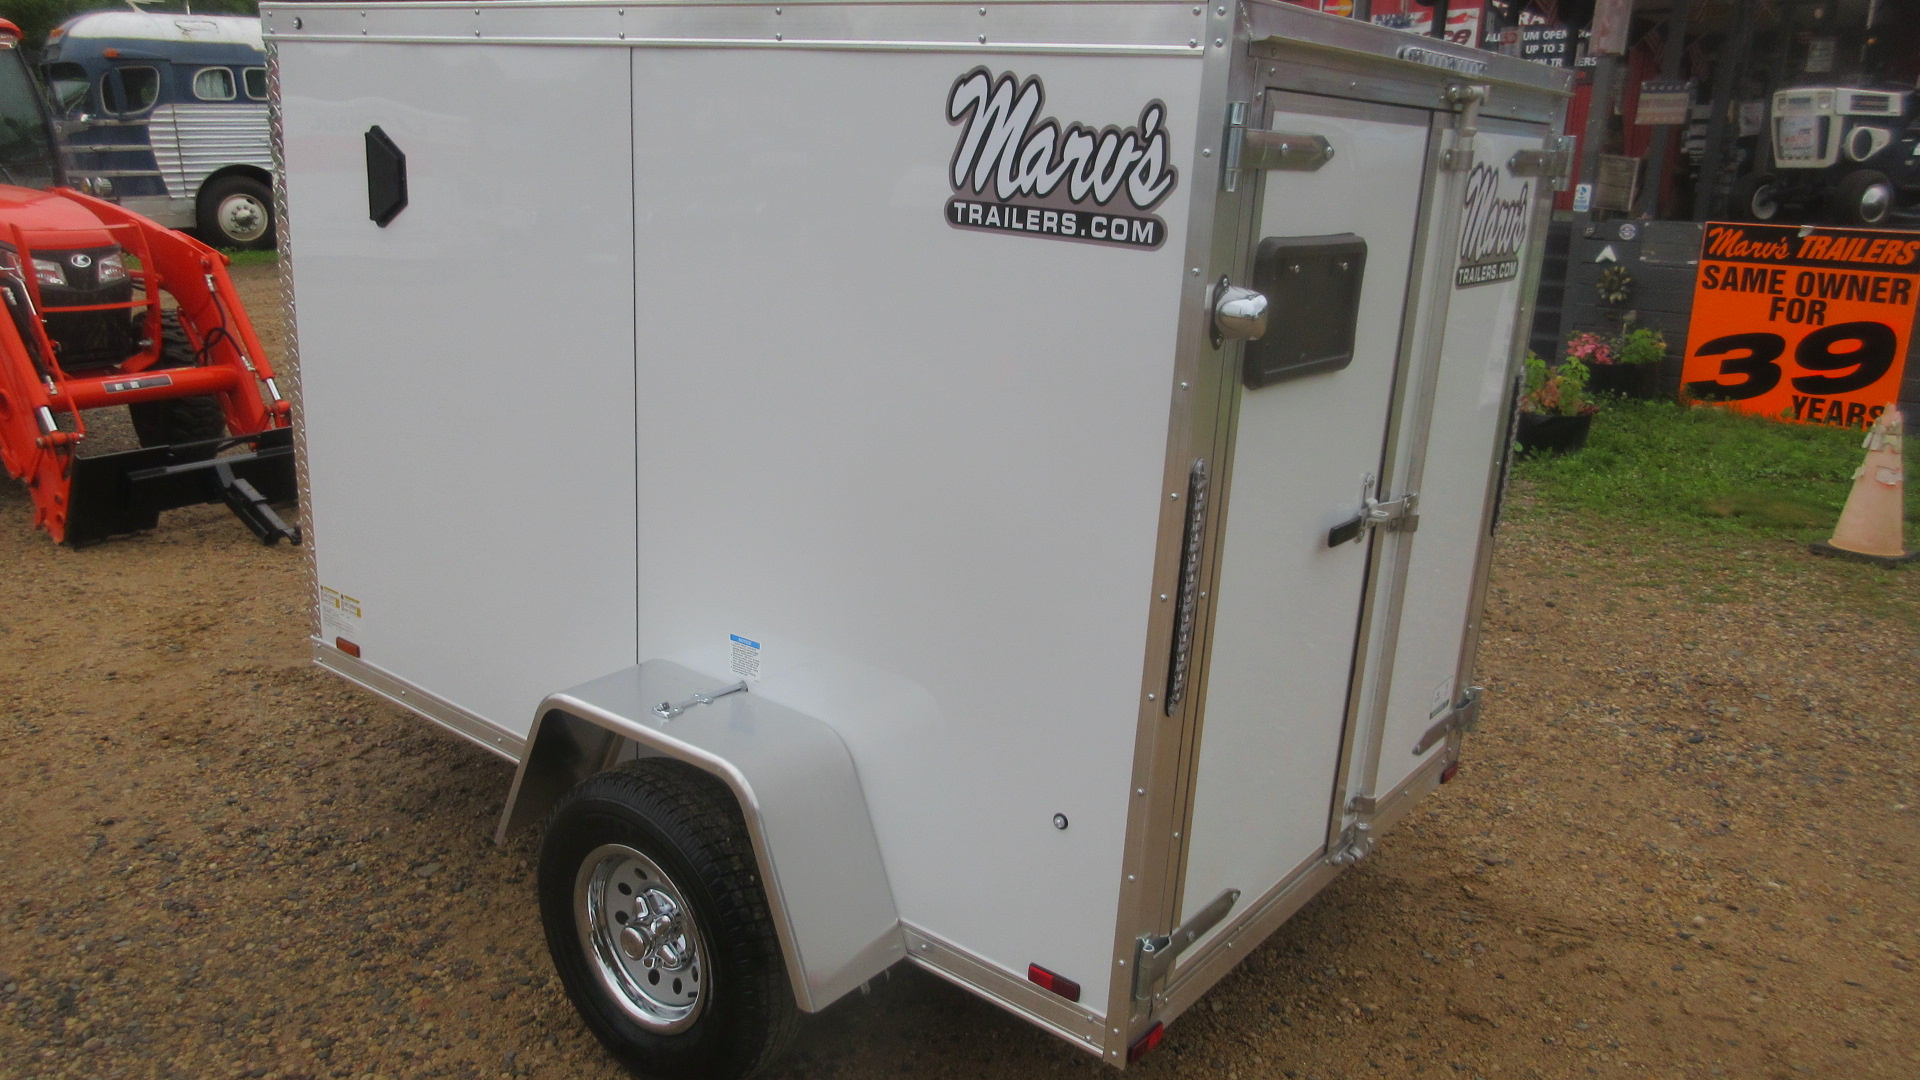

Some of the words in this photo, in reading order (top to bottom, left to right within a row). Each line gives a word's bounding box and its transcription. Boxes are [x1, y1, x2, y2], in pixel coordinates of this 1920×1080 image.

[1525, 44, 1539, 54] UP
[1542, 43, 1555, 54] TO
[949, 70, 1174, 211] Marv's
[953, 202, 1155, 244] TRAILERS.COM
[1708, 226, 1791, 260] Marv's
[1796, 235, 1920, 266] TRAILERS
[1458, 261, 1517, 285] TRAILERS.COM
[1702, 264, 1787, 296] SAME
[1795, 270, 1912, 306] OWNER
[1768, 296, 1828, 326] FOR
[1685, 321, 1898, 403] 39
[1791, 394, 1885, 428] YEARS
